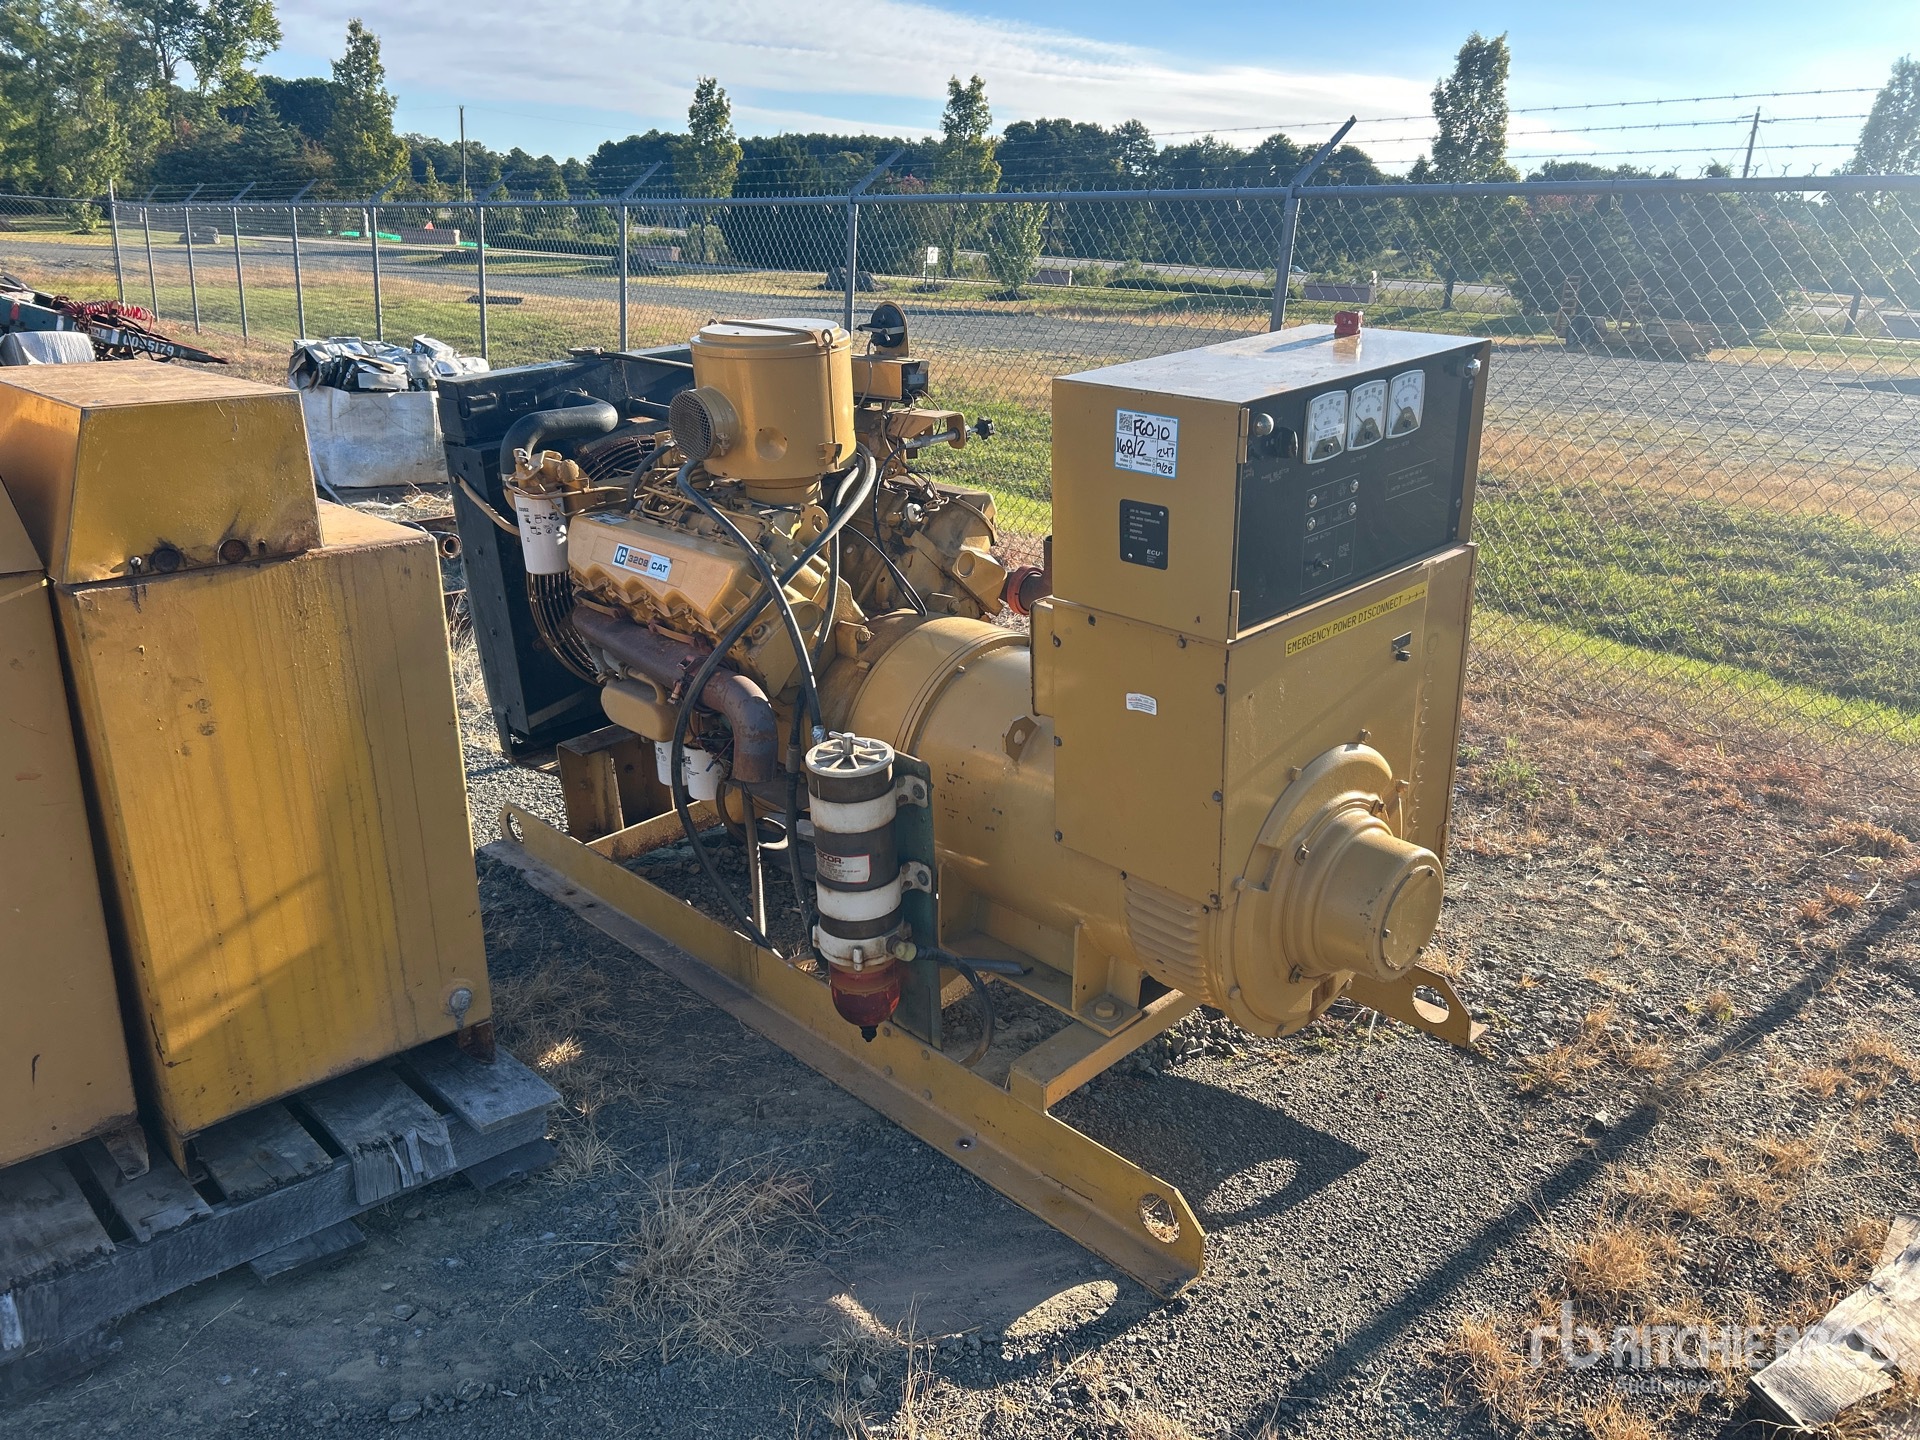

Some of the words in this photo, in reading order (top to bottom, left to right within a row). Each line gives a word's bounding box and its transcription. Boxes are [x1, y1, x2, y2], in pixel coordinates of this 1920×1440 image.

[1156, 447, 1175, 458] 247
[1146, 549, 1161, 557] ECU
[627, 554, 649, 567] 3208
[651, 561, 669, 573] CAT
[1287, 625, 1332, 654] EMERGENCY
[1332, 615, 1358, 634] POWER
[1358, 595, 1404, 623] DISCONNECT
